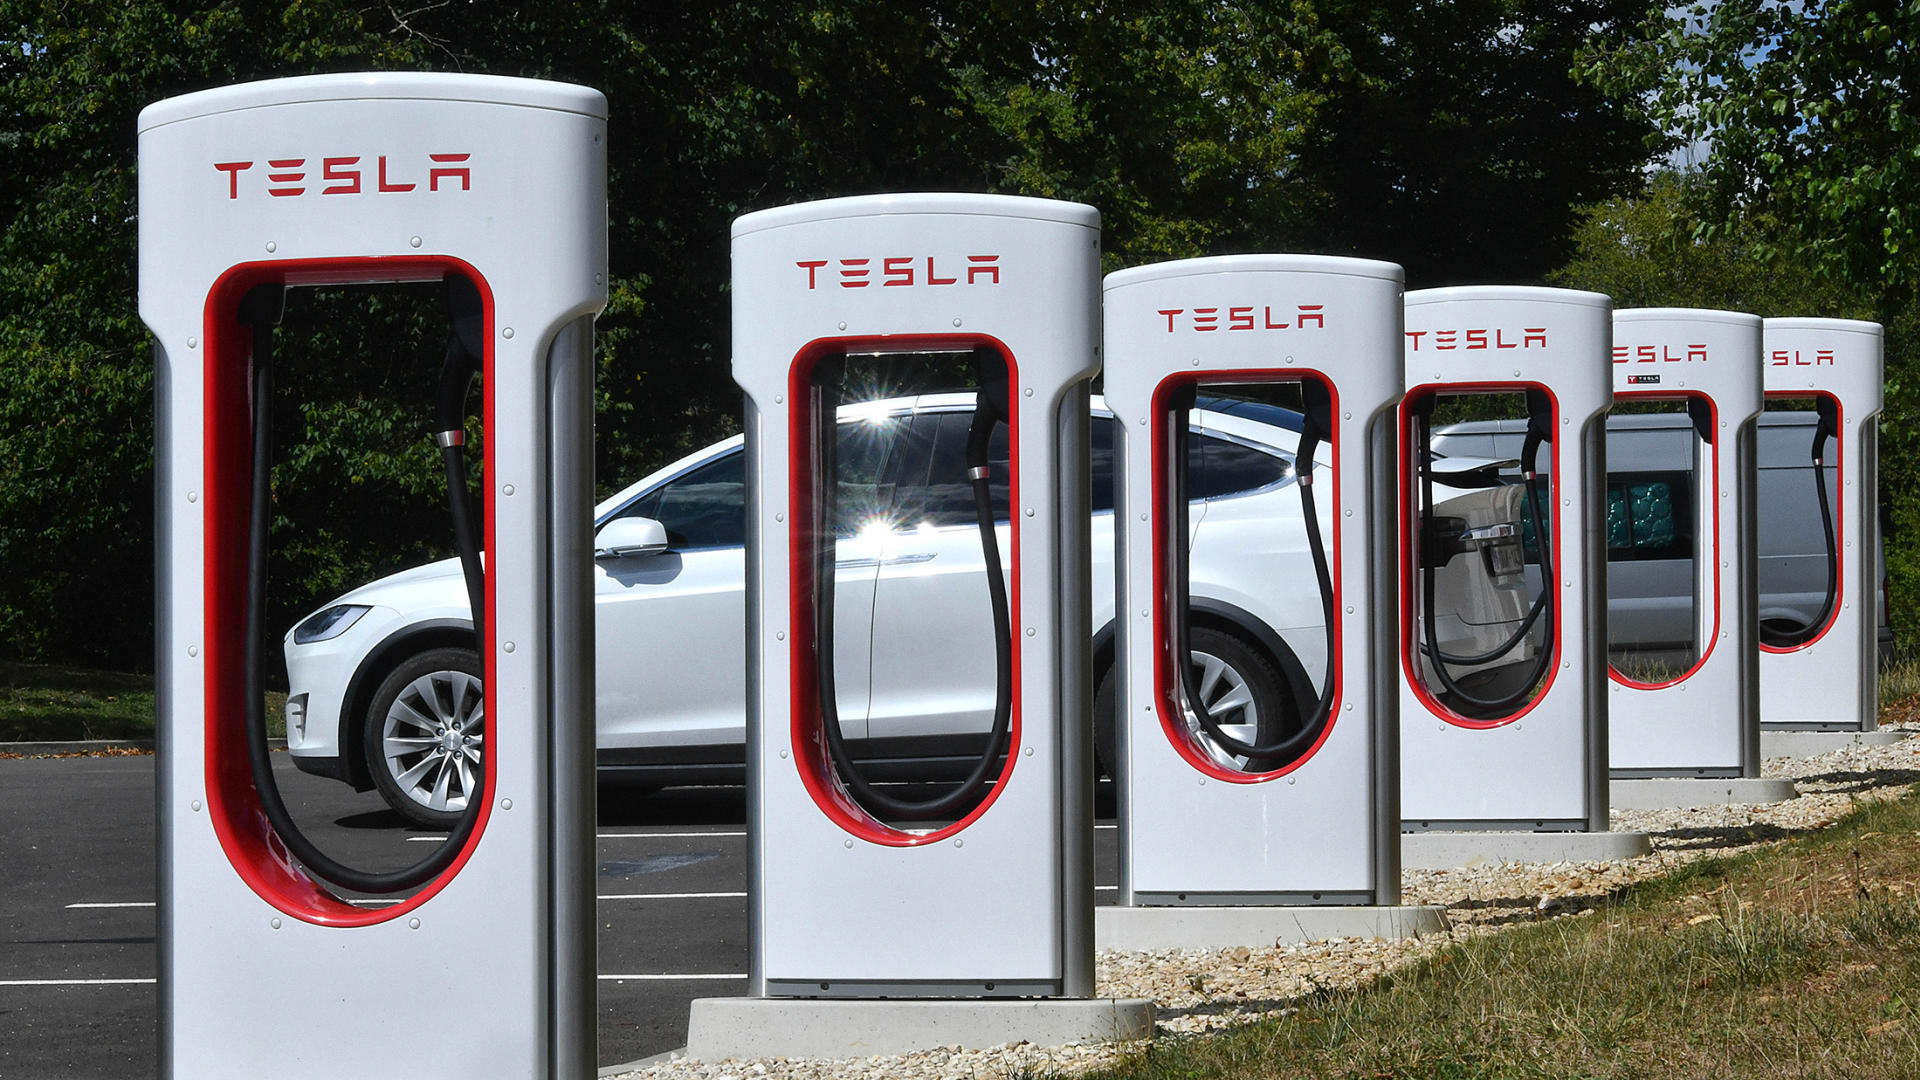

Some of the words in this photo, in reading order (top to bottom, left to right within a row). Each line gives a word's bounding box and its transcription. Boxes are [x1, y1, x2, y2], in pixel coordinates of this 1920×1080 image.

[215, 153, 471, 200] TESLA
[796, 255, 1000, 290] TESLA
[1158, 305, 1324, 333] TESLA
[1404, 327, 1547, 352] TESLA
[1612, 344, 1707, 364] ESLA
[1766, 350, 1834, 367] SLA
